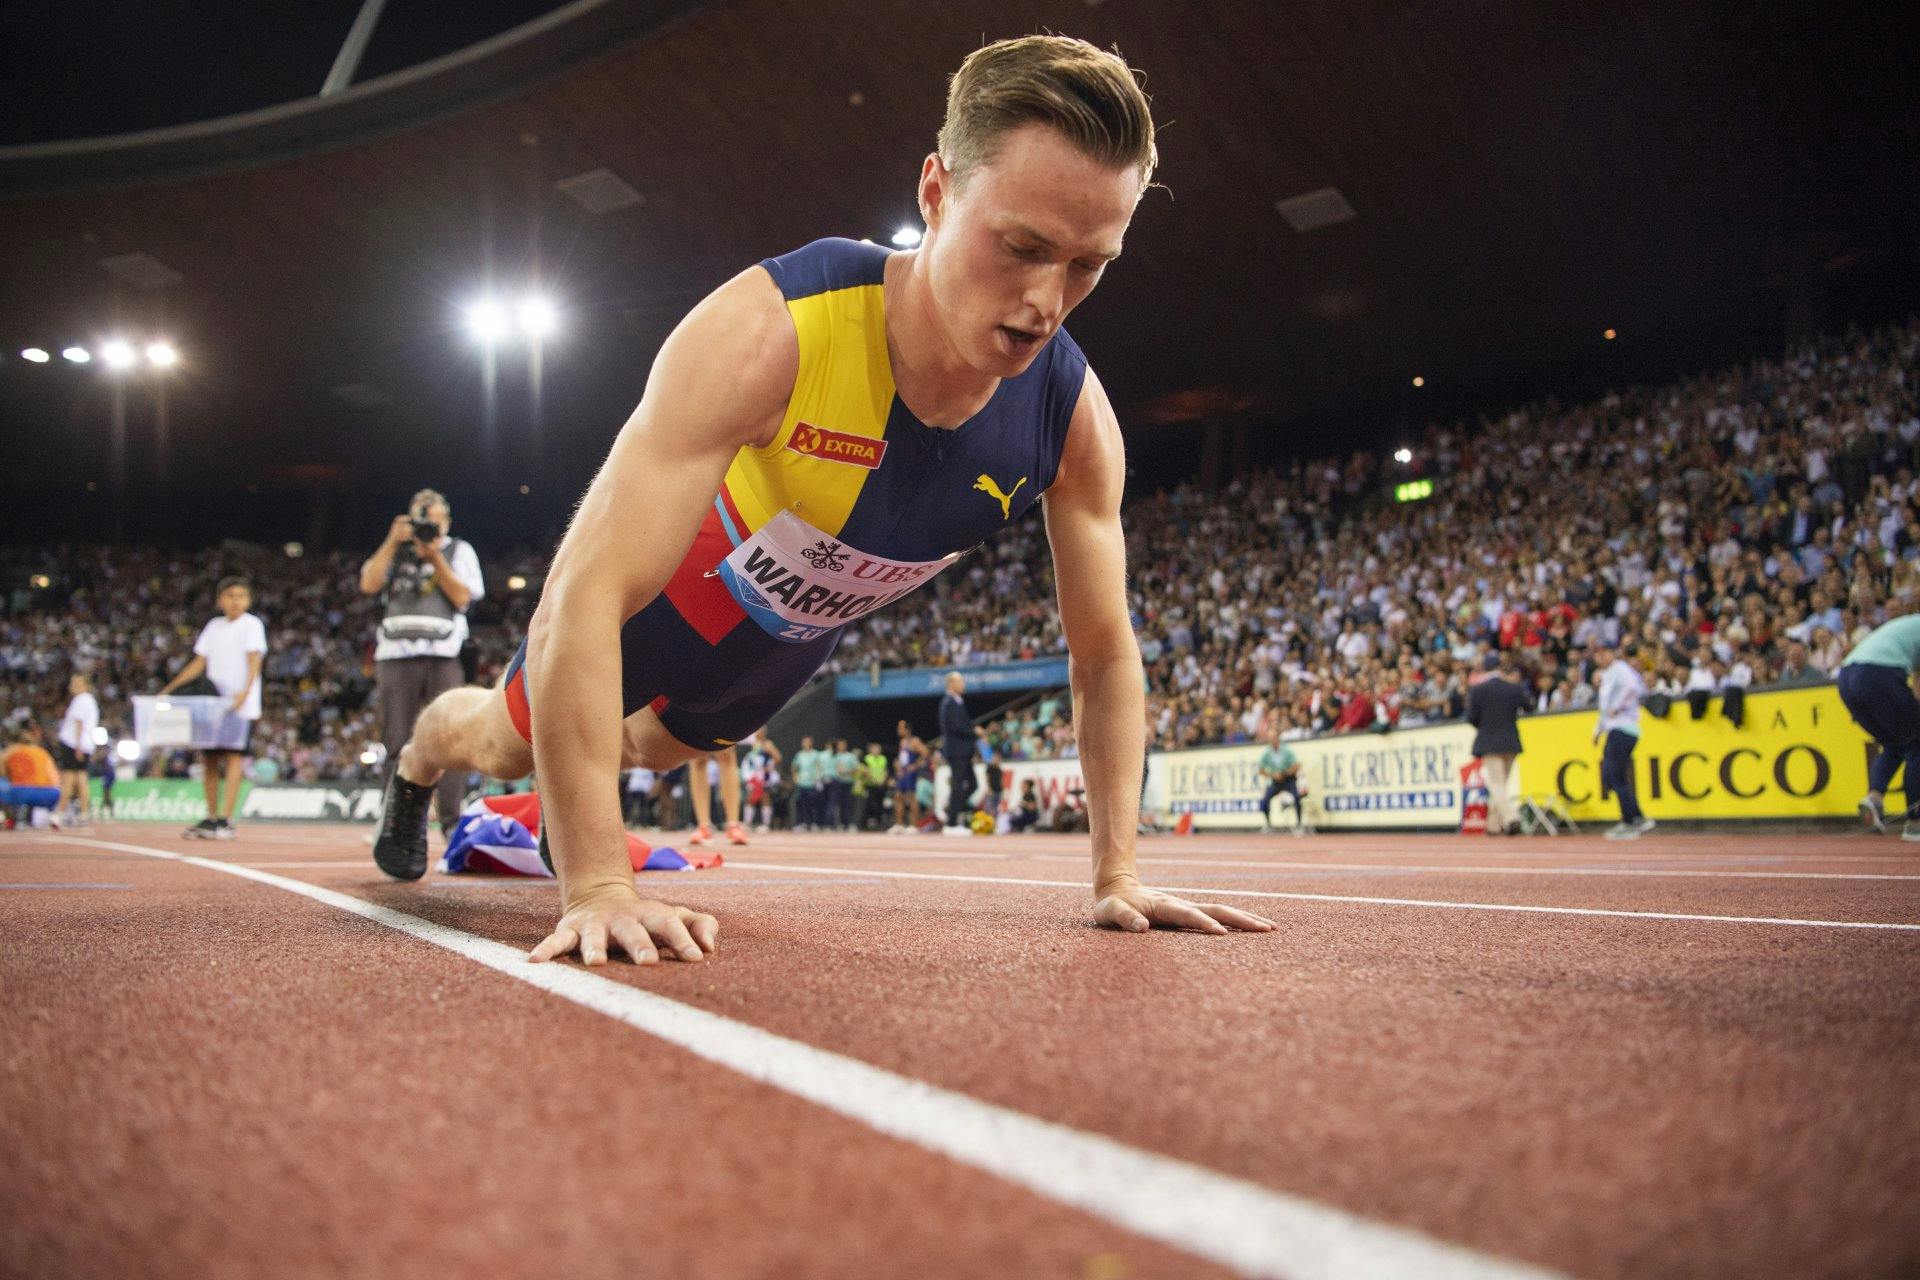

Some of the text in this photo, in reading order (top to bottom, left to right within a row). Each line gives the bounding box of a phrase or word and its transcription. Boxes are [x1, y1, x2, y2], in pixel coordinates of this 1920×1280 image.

[824, 439, 875, 460] EXTRA
[853, 559, 933, 583] UBS
[1193, 756, 1262, 793] GRUYÈR
[1322, 741, 1454, 788] LE GRUYÈRE
